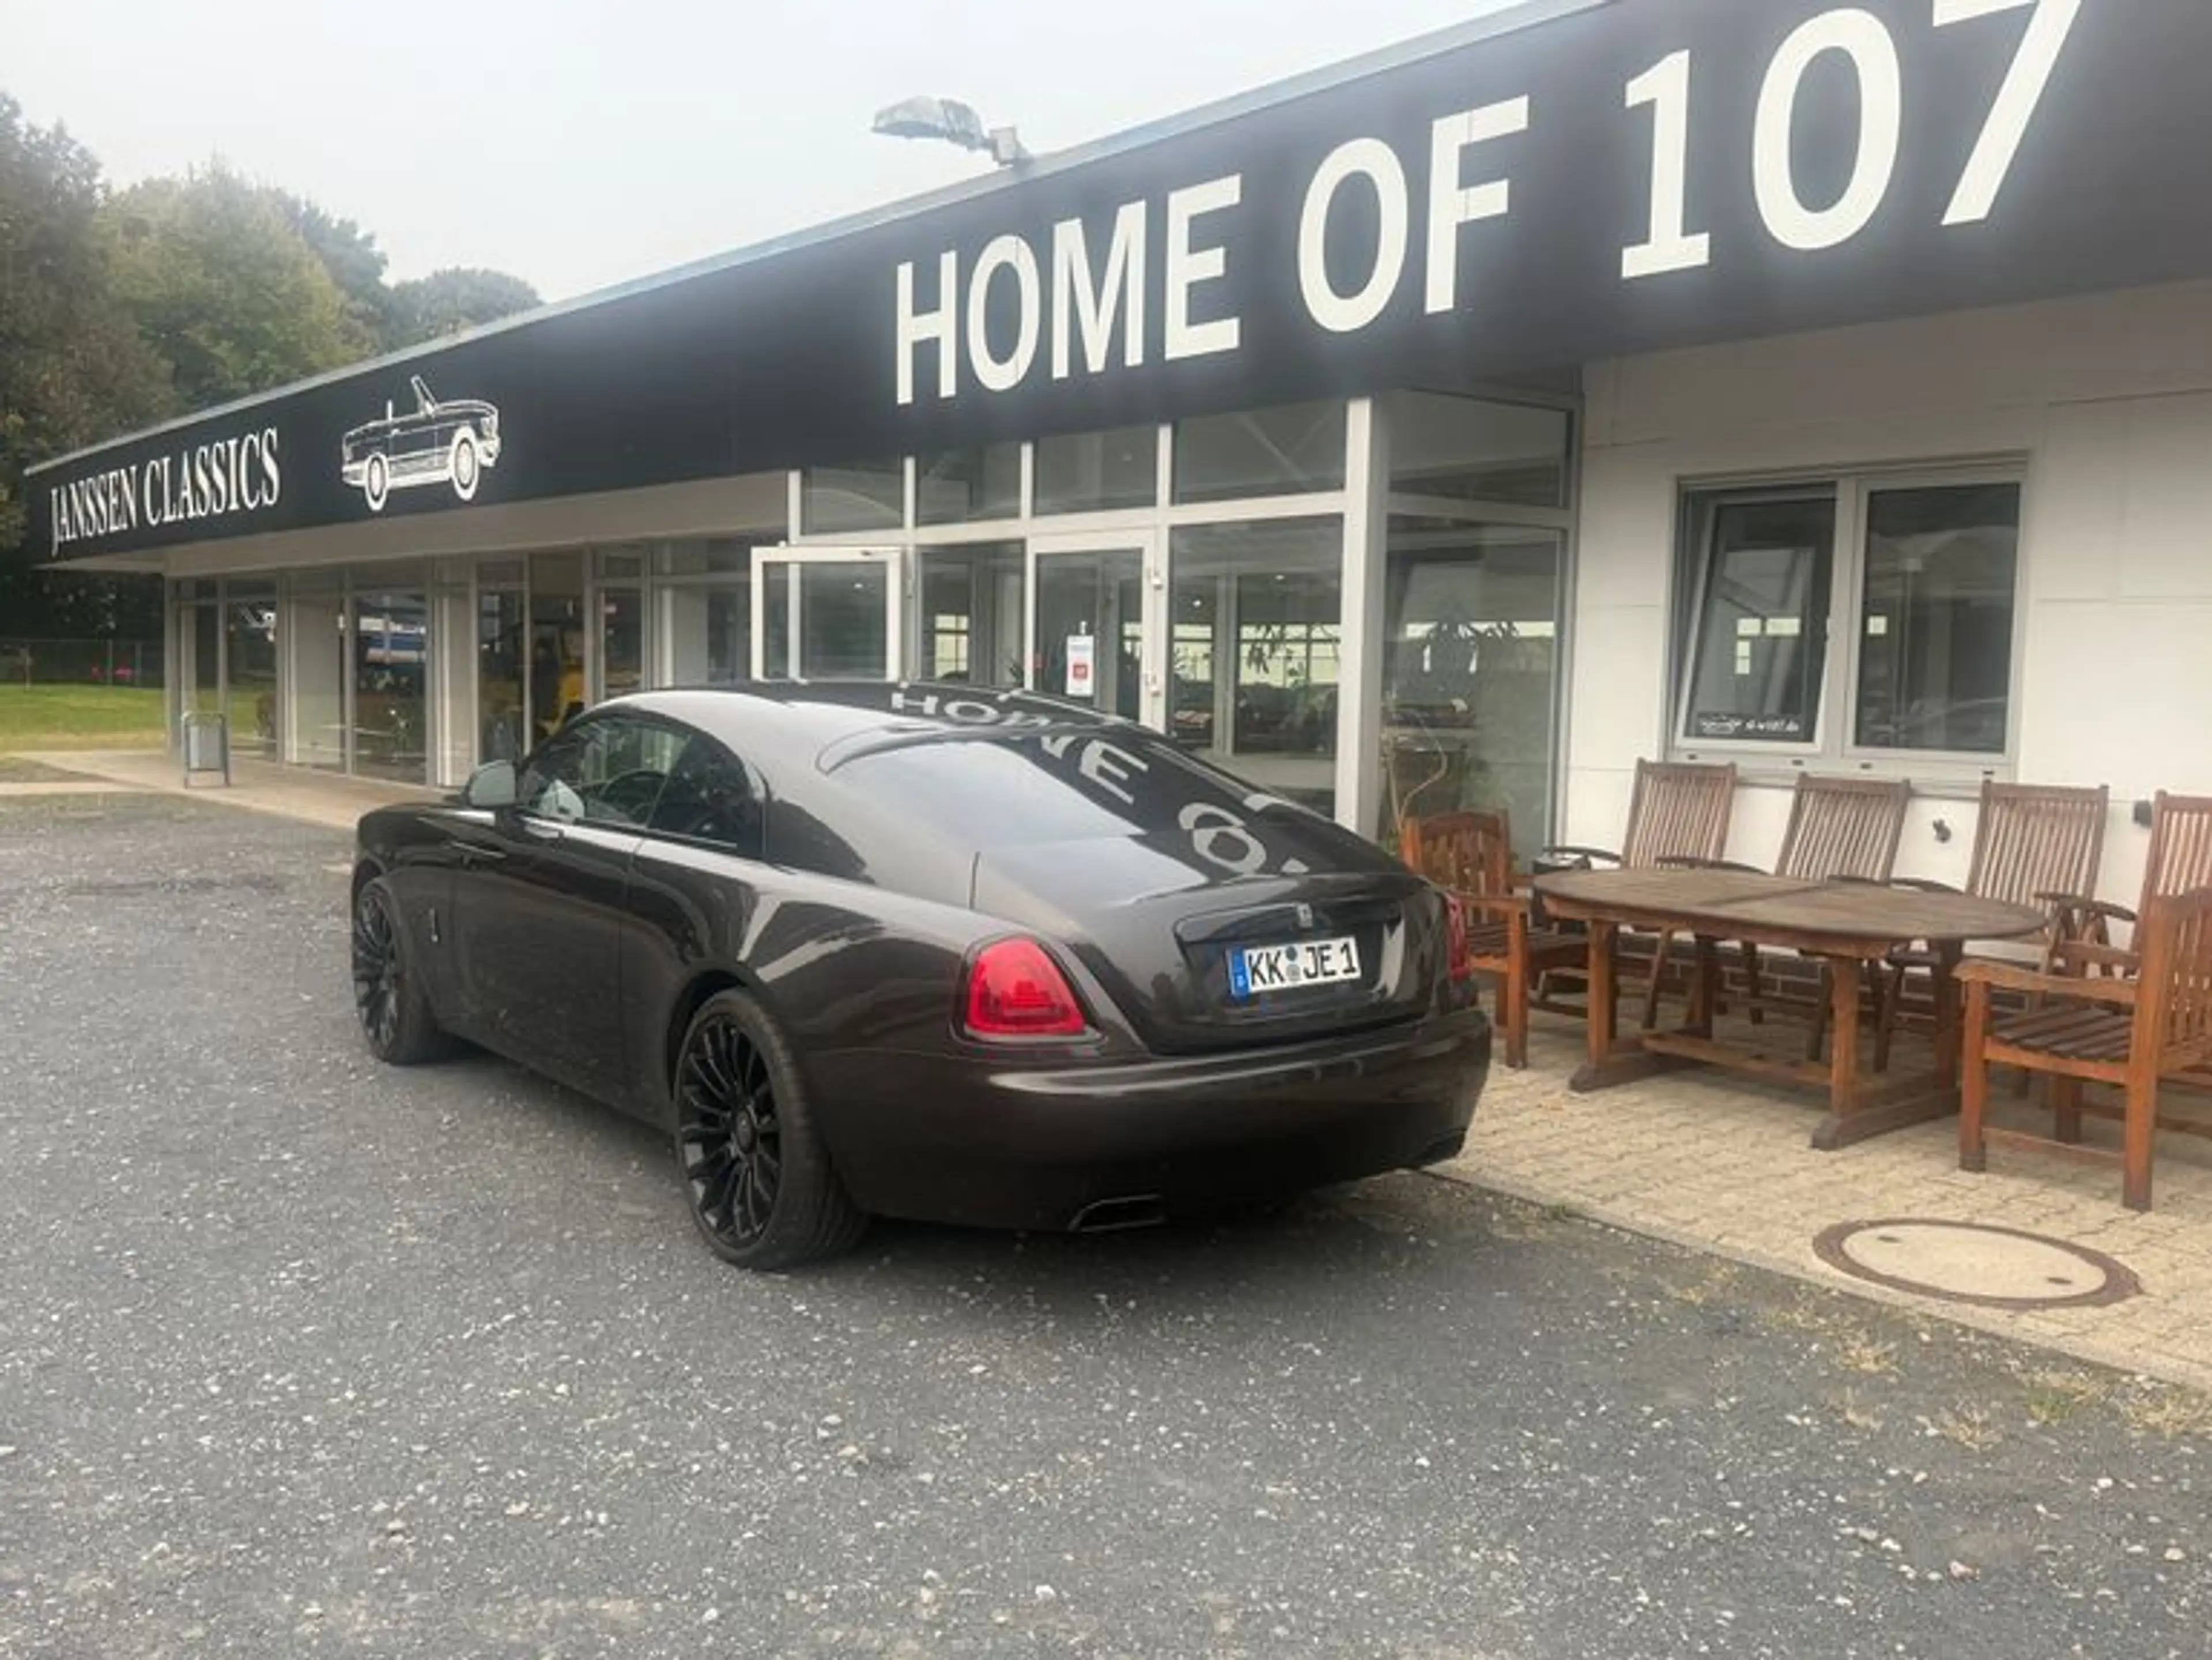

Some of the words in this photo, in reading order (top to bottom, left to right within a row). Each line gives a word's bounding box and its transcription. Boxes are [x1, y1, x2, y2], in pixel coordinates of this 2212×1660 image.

[896, 173, 1241, 404] HOME
[1298, 94, 1529, 333] OF
[1621, 0, 2082, 278] 107
[51, 465, 138, 557] JANSSEN
[144, 427, 280, 527] CLASSICS
